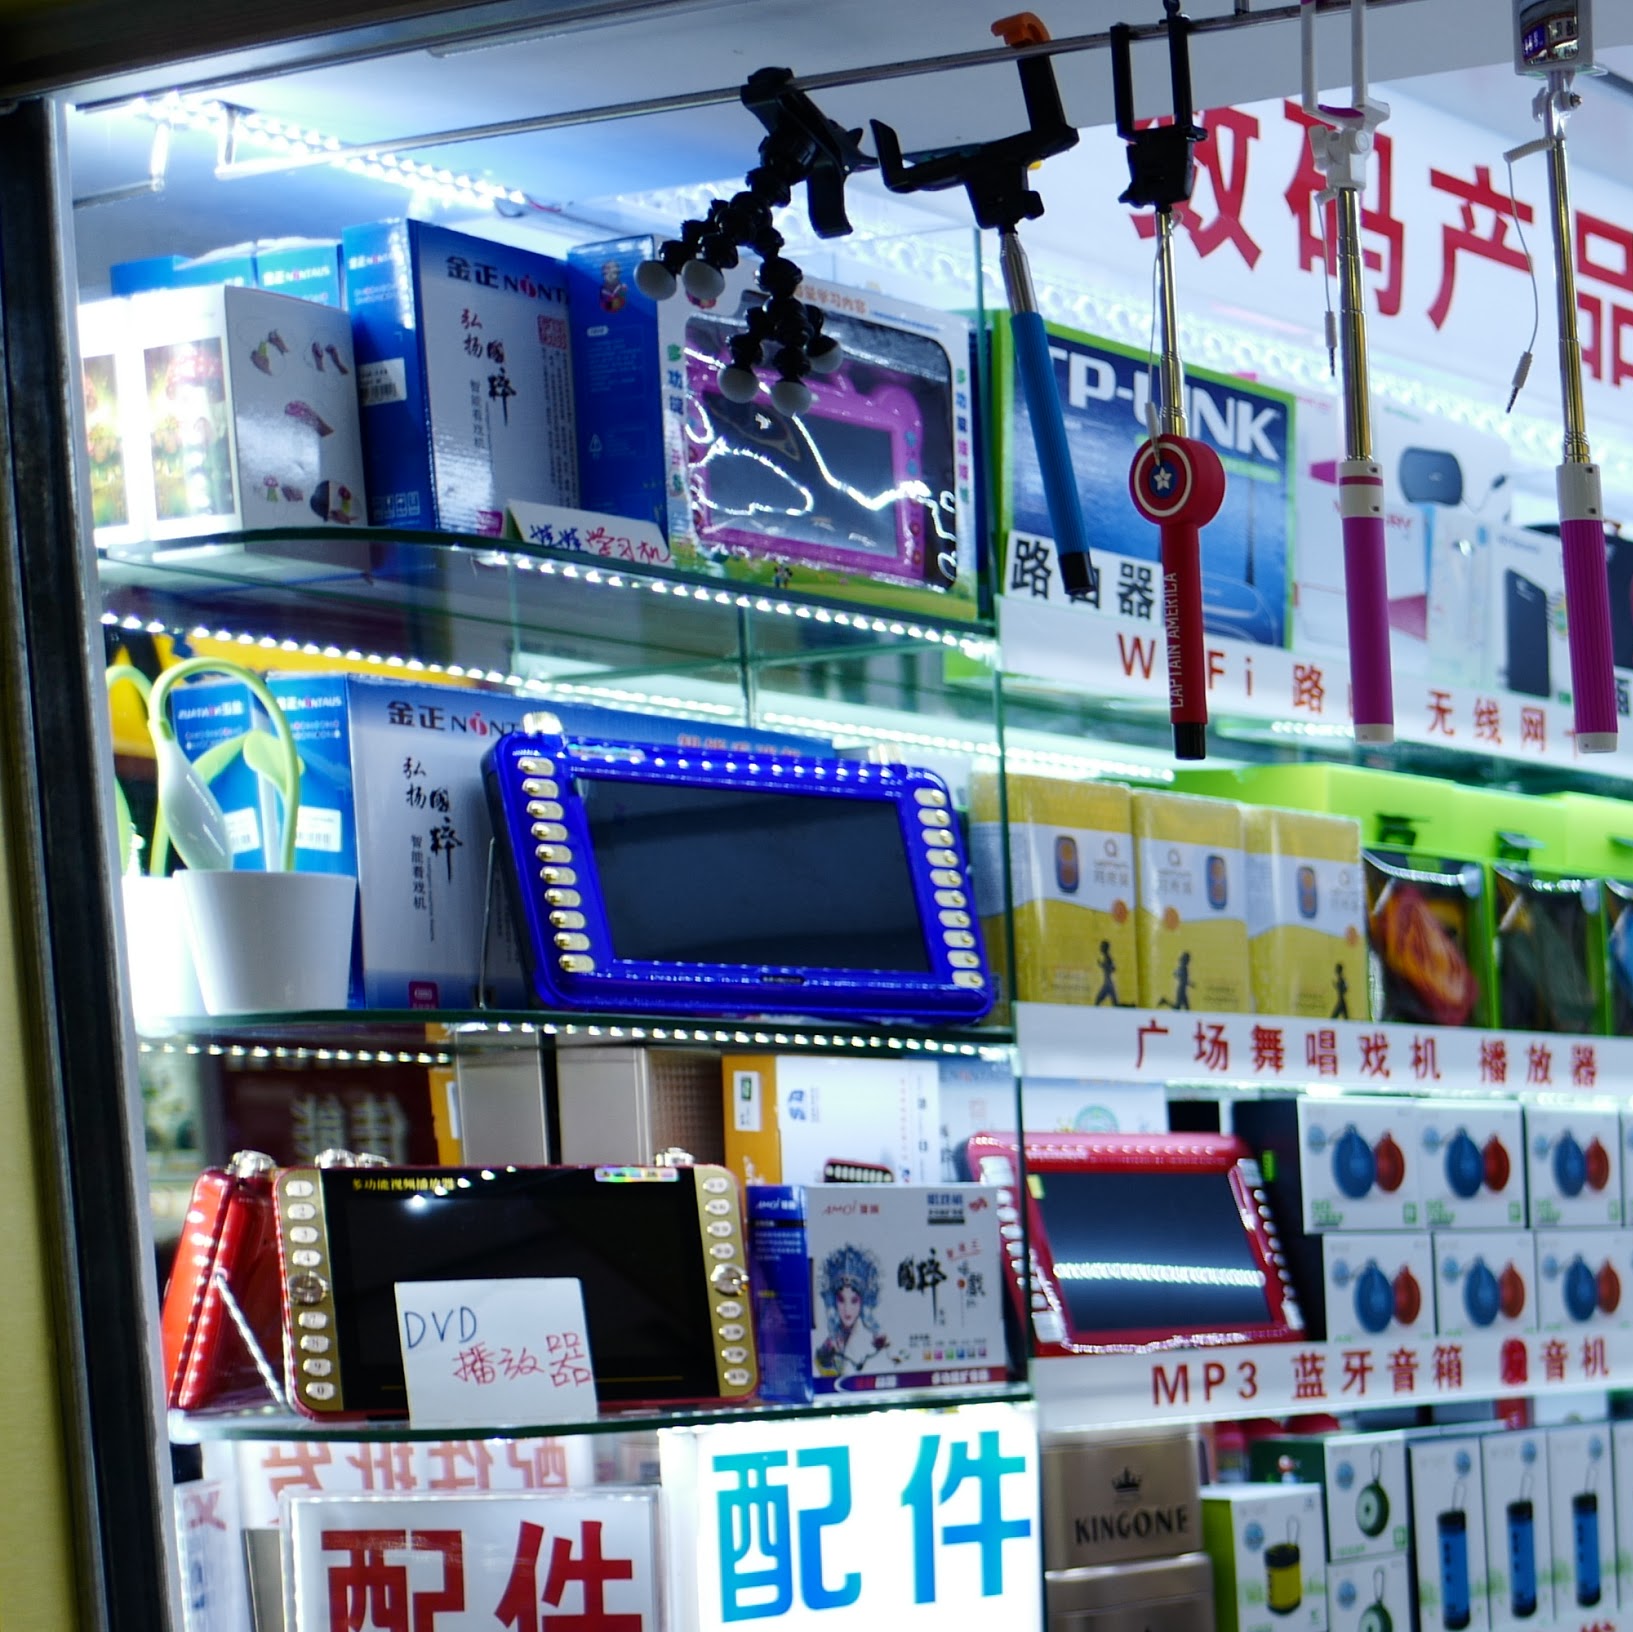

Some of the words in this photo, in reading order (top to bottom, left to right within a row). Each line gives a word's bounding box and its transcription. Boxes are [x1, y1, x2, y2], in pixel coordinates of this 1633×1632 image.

[446, 256, 499, 289] 金正
[1164, 572, 1182, 640] AMERICA
[1117, 633, 1253, 696] WFi
[1427, 688, 1579, 758] 无线网
[1169, 644, 1184, 708] CAPTAIN
[387, 700, 444, 733] 金正
[1136, 1020, 1441, 1081] 广场舞唱戏机
[1479, 1038, 1599, 1088] 播放器
[404, 1305, 478, 1350] DVD
[453, 1331, 593, 1388] 播放器
[1151, 1360, 1260, 1404] MP3
[1291, 1344, 1465, 1402] 蓝牙音箱
[712, 1428, 1033, 1624] 配件
[1074, 1505, 1191, 1546] KINGONE
